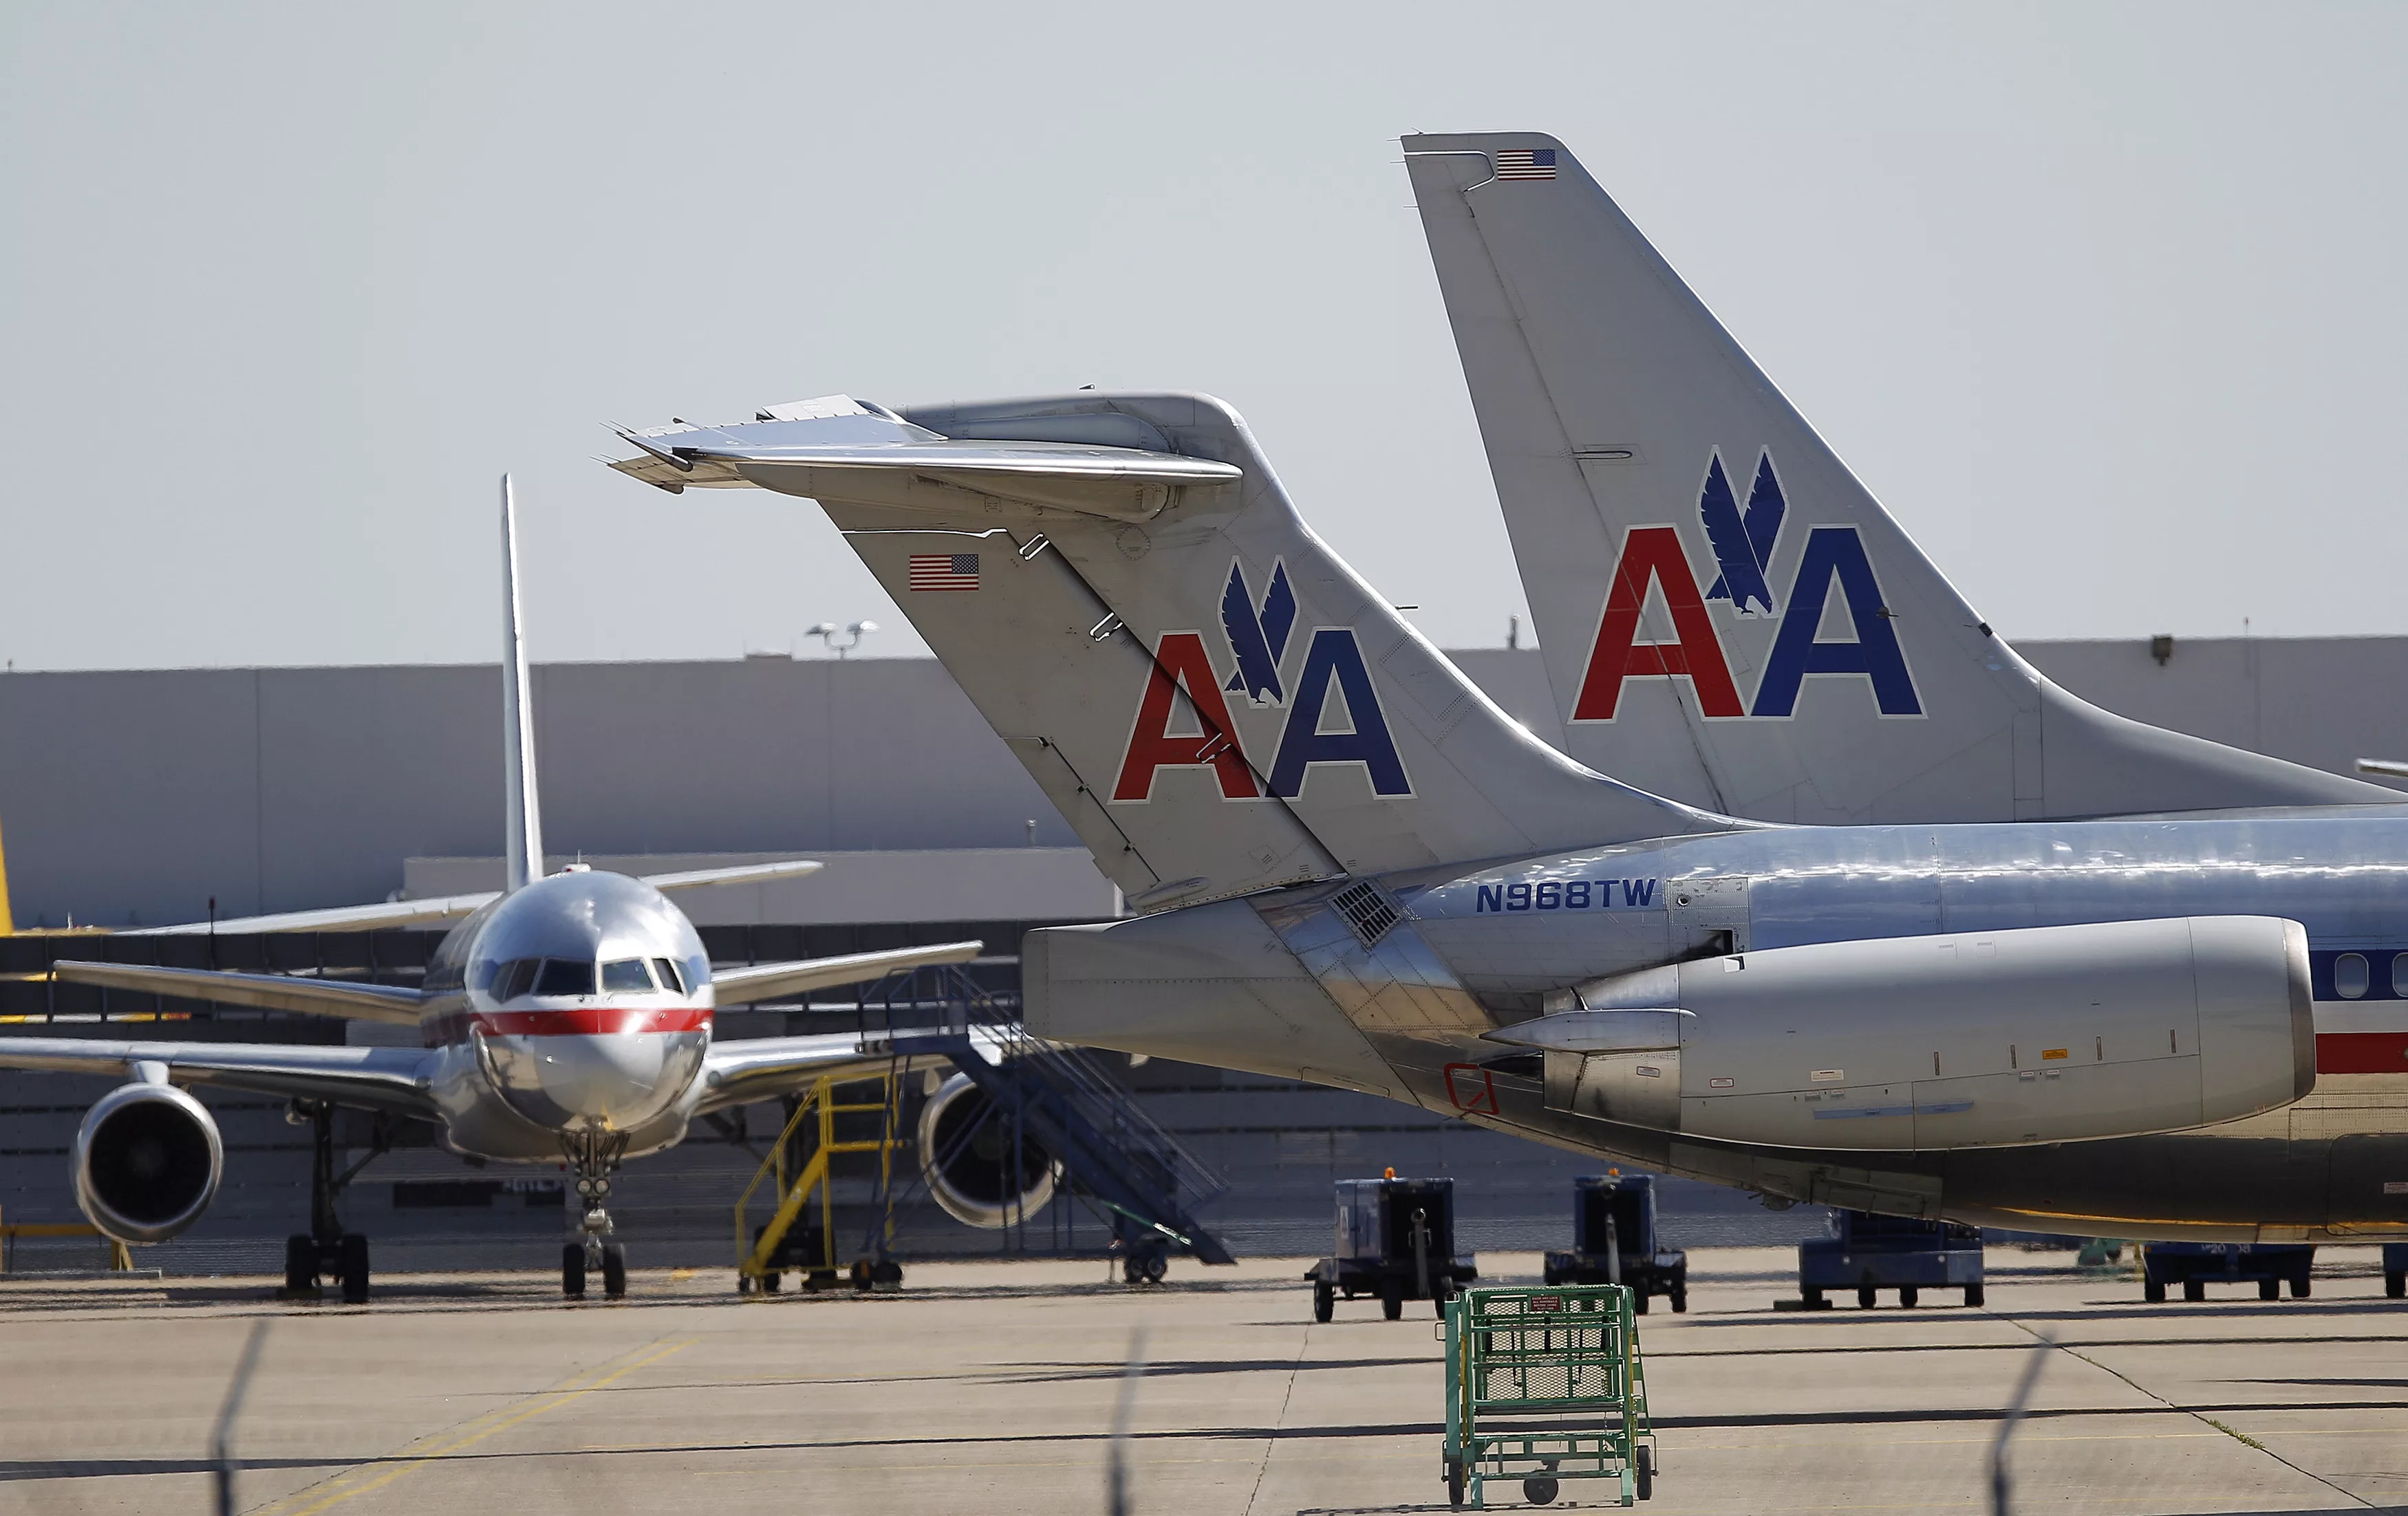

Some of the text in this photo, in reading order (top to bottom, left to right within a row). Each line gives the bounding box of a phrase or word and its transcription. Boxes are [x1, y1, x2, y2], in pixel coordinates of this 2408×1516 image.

[1569, 523, 1928, 724] AA
[1108, 625, 1417, 805] AA
[1476, 878, 1657, 913] N968TW
